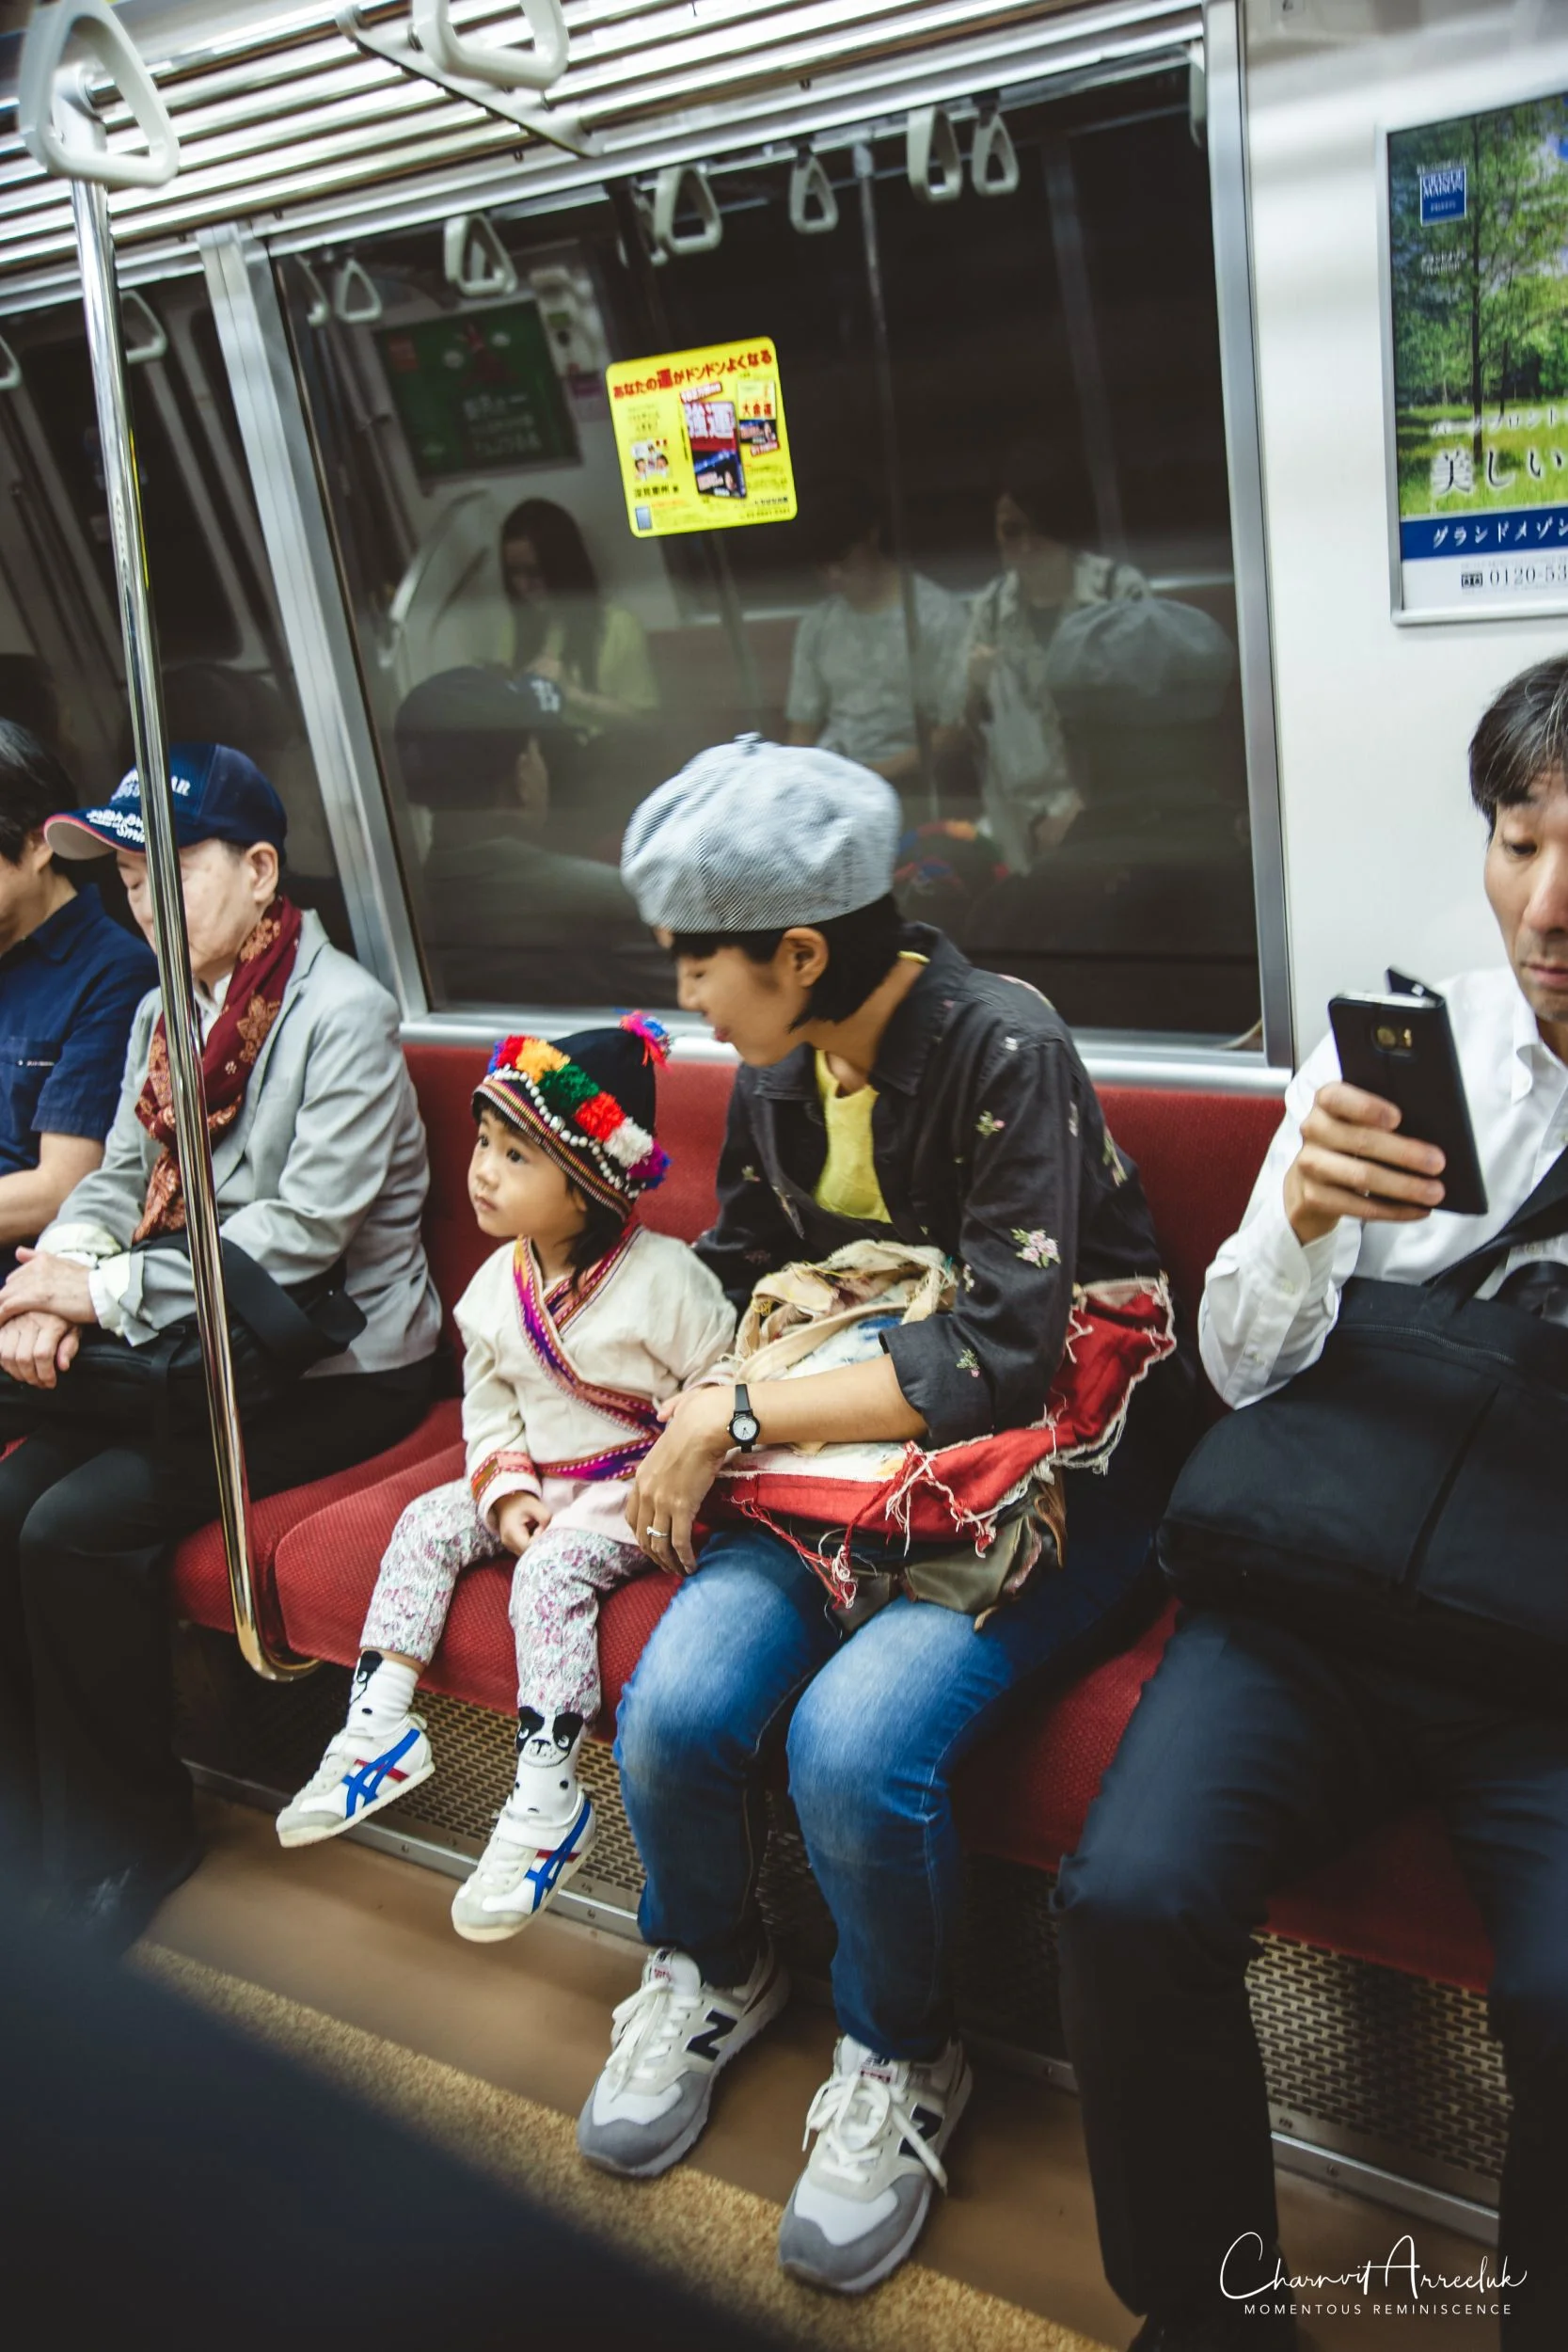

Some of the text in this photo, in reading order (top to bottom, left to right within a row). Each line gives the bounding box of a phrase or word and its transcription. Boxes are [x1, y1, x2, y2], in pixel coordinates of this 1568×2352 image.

[613, 349, 772, 399] あなたの運がドンドンよくなる
